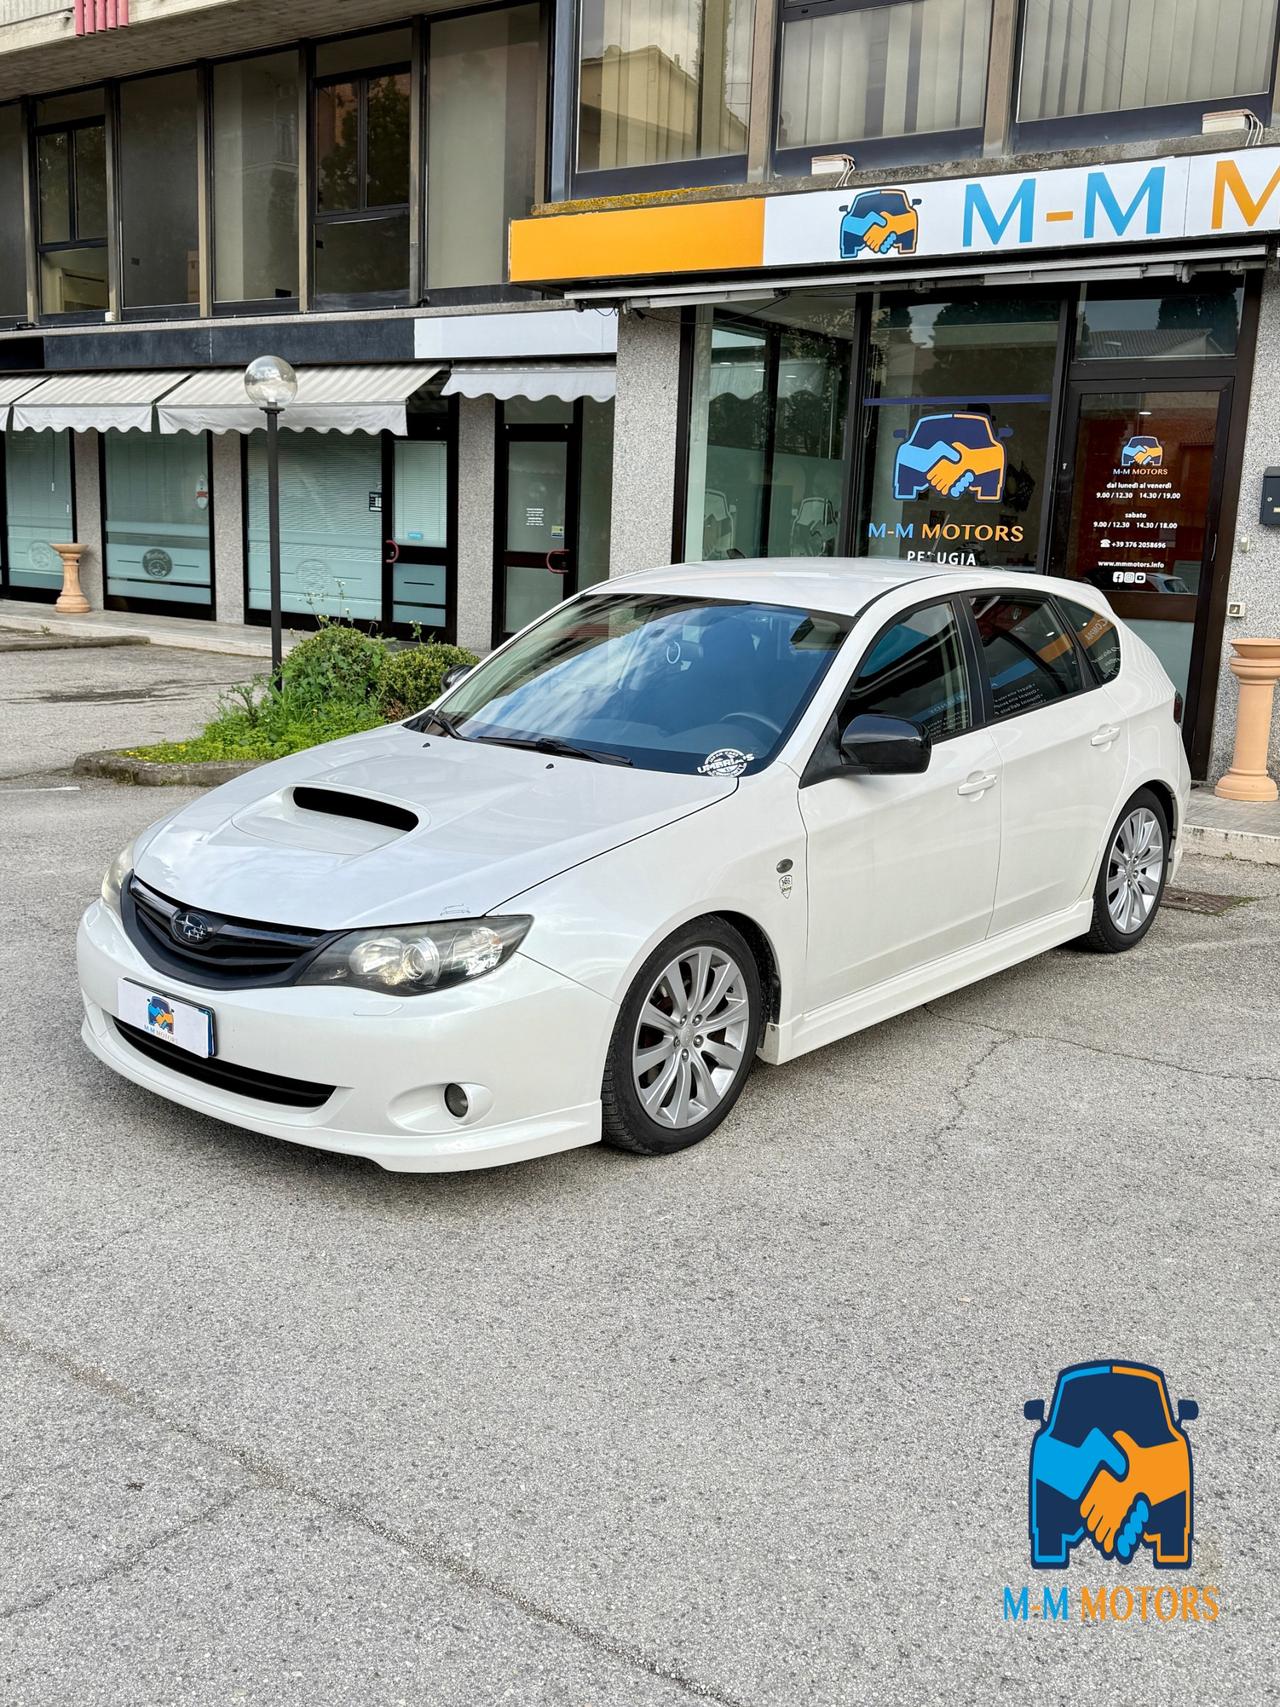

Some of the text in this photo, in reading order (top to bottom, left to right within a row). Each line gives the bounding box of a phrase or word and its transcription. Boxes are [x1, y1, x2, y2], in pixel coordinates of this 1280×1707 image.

[962, 166, 1166, 247] M-M
[868, 523, 1024, 542] M-M MOTORS
